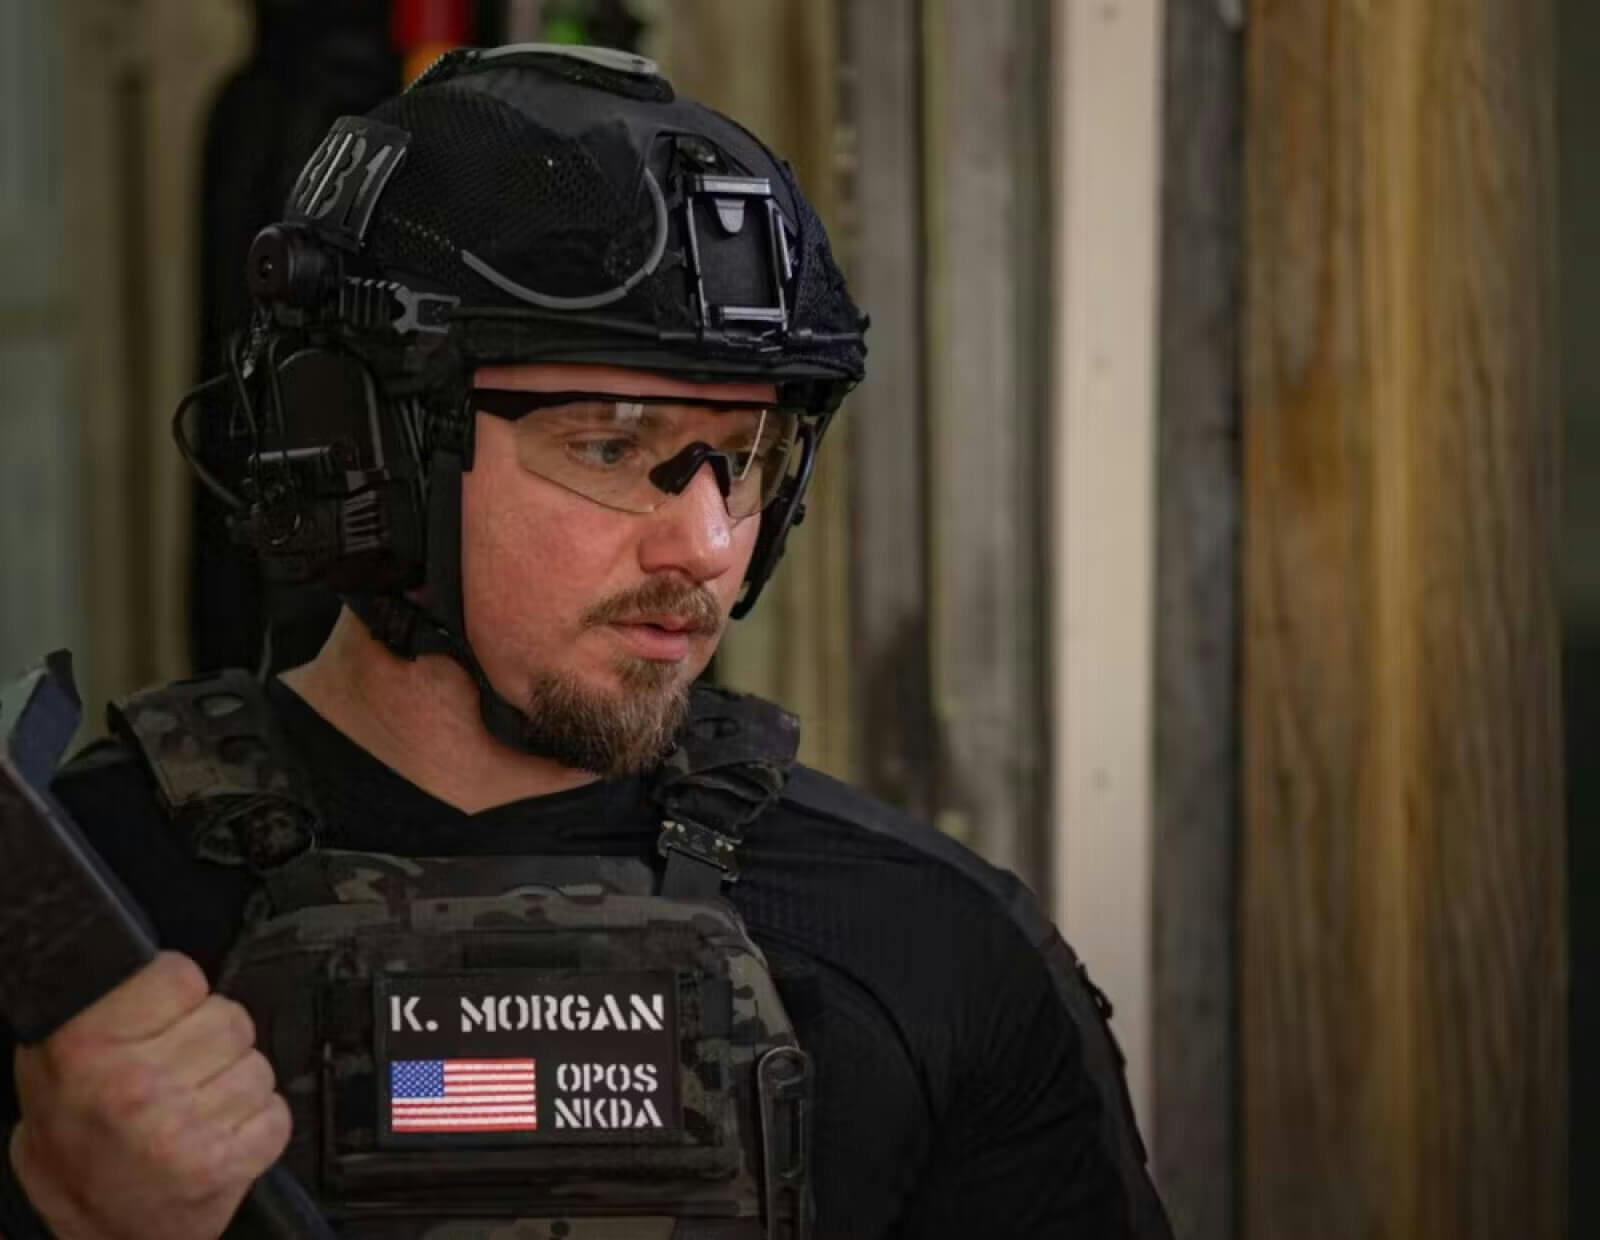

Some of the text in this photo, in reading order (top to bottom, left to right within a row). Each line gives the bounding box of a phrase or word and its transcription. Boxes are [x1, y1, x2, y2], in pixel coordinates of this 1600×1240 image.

[390, 993, 664, 1032] K. MORGAN
[556, 1063, 658, 1093] OPOS
[554, 1098, 663, 1128] NKDA
